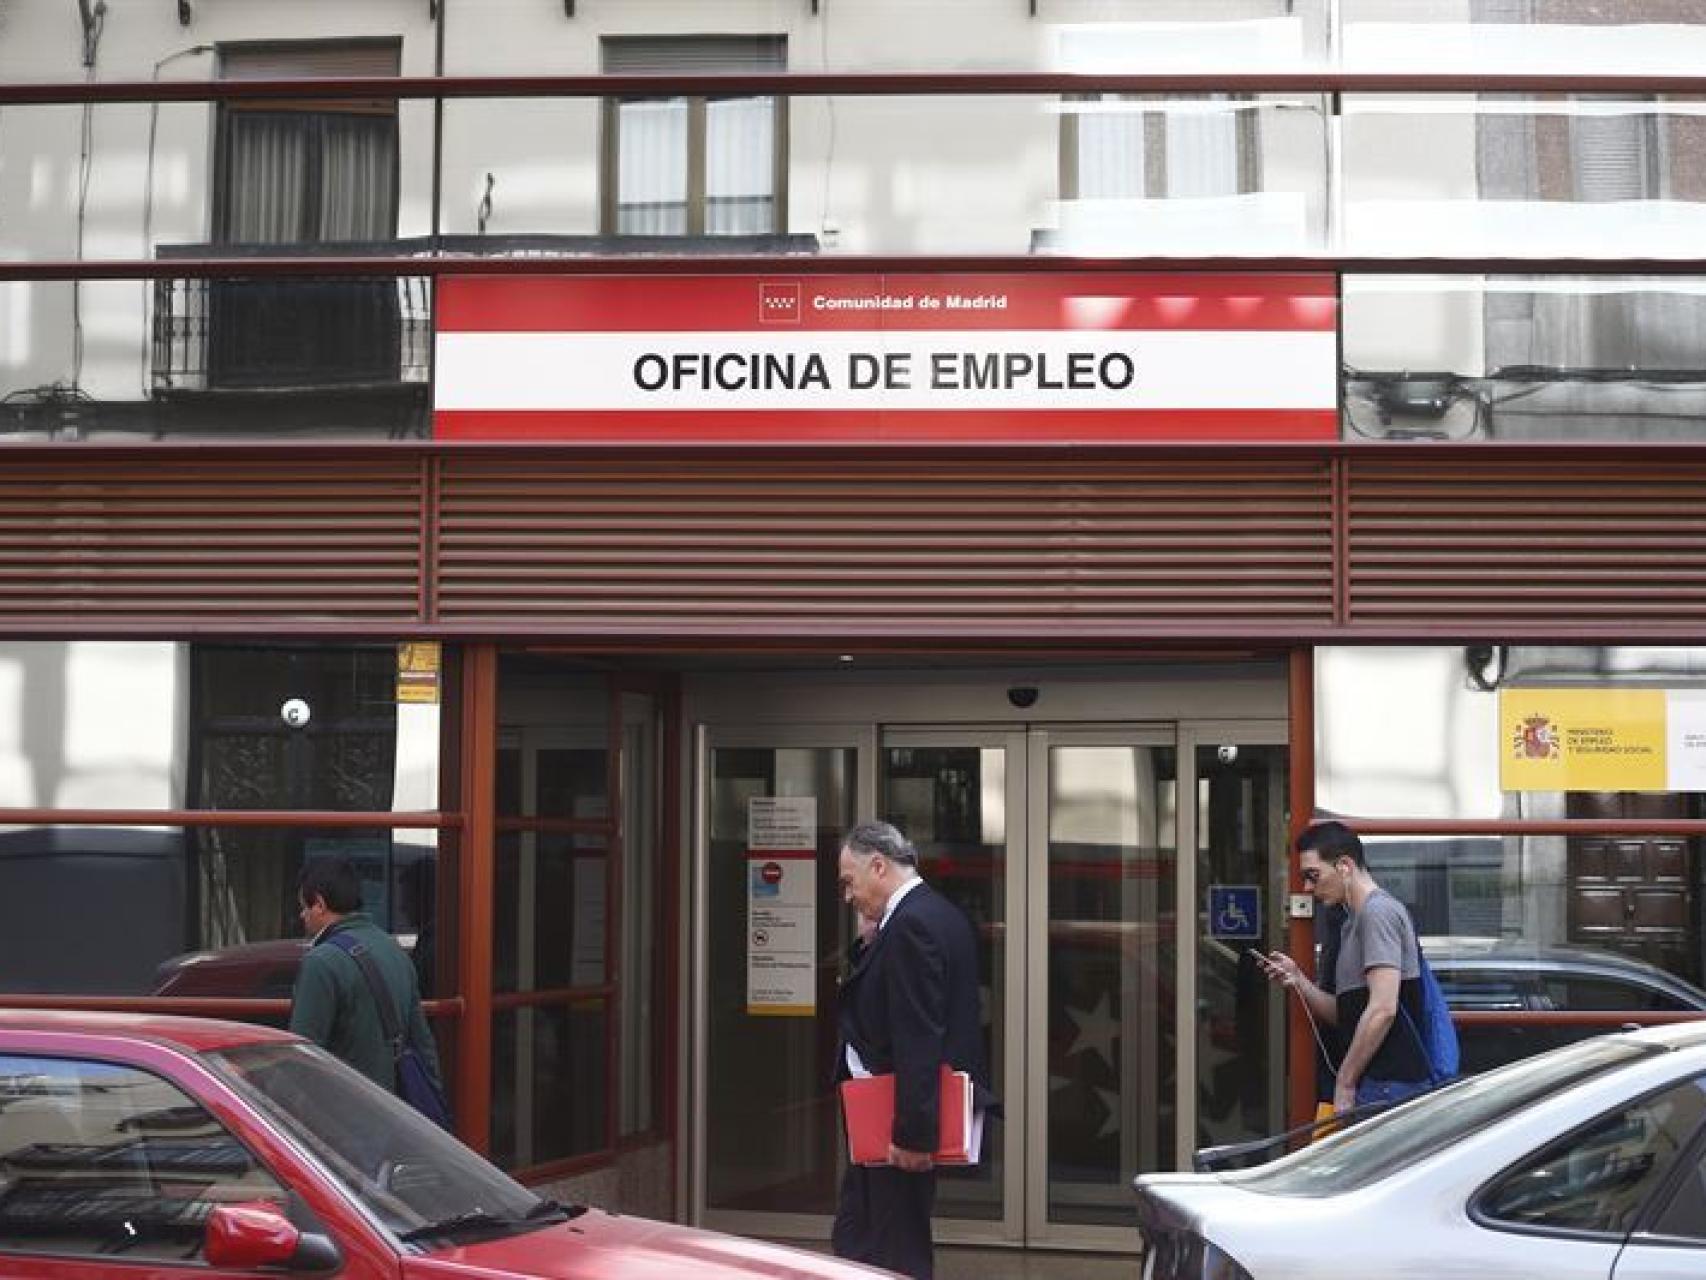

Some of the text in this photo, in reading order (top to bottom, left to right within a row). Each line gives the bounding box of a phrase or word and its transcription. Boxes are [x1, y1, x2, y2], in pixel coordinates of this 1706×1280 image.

[814, 295, 1008, 309] Comunidad de Madrid
[633, 352, 1135, 391] OFICINA DE EMPLEO
